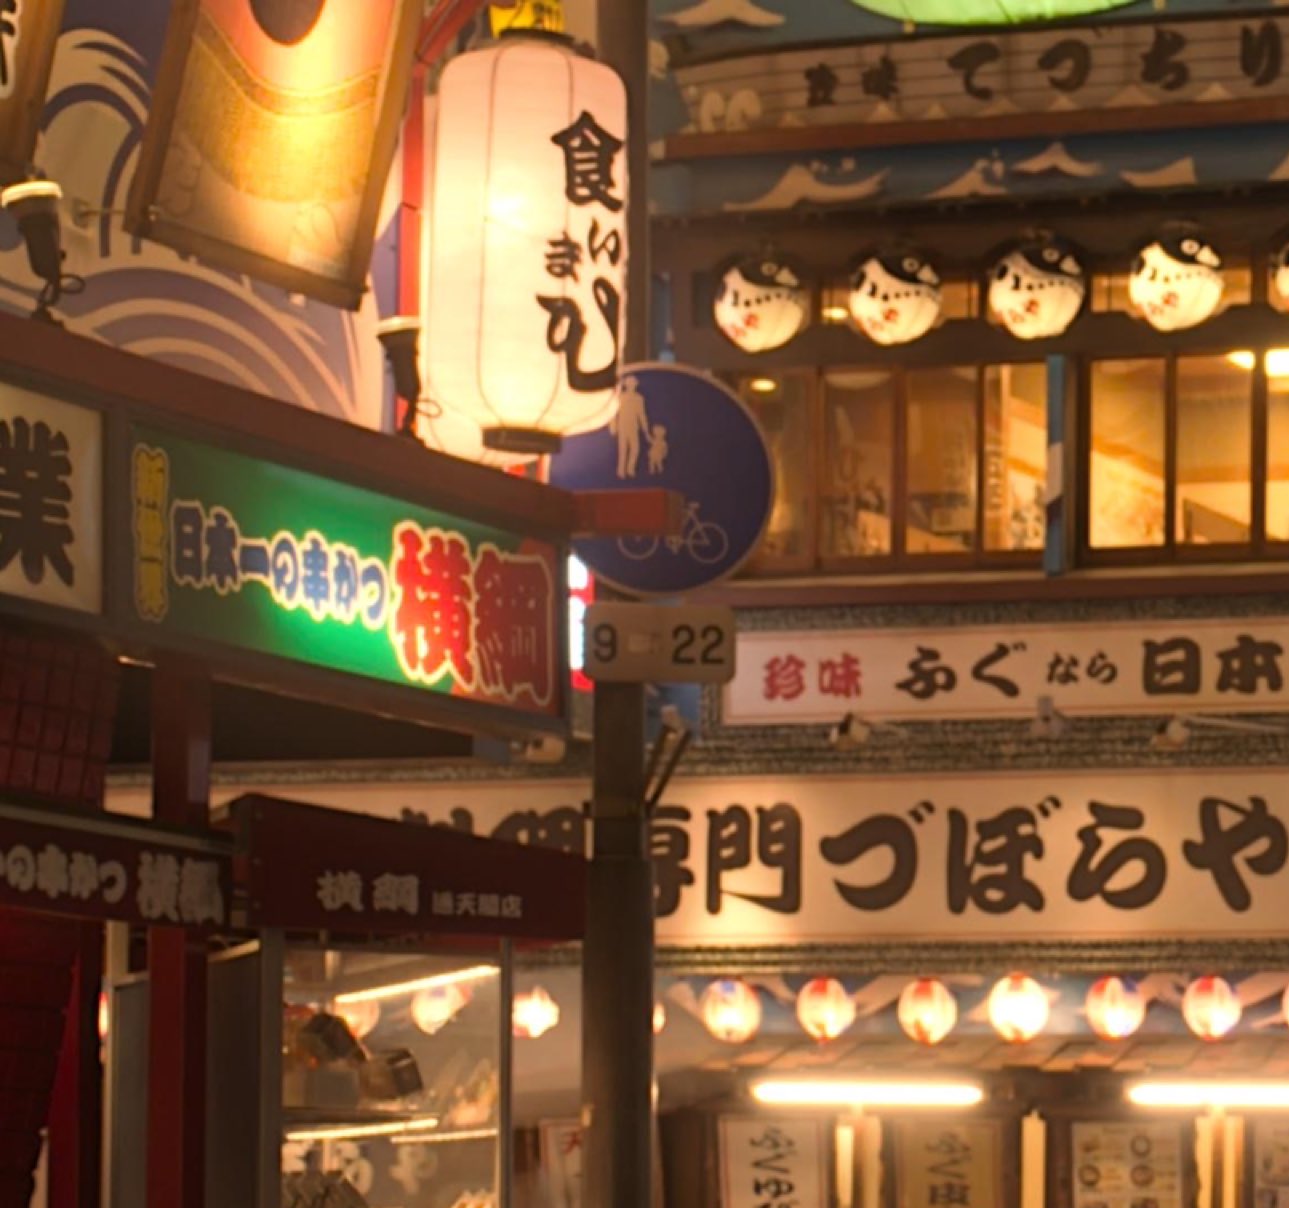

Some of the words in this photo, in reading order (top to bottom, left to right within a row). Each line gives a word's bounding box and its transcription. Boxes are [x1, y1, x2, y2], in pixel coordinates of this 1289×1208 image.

[394, 522, 551, 702] 横綱
[672, 624, 724, 664] 22
[763, 653, 863, 701] 珍味
[895, 638, 1027, 700] ふぐ
[1046, 651, 1118, 684] なら
